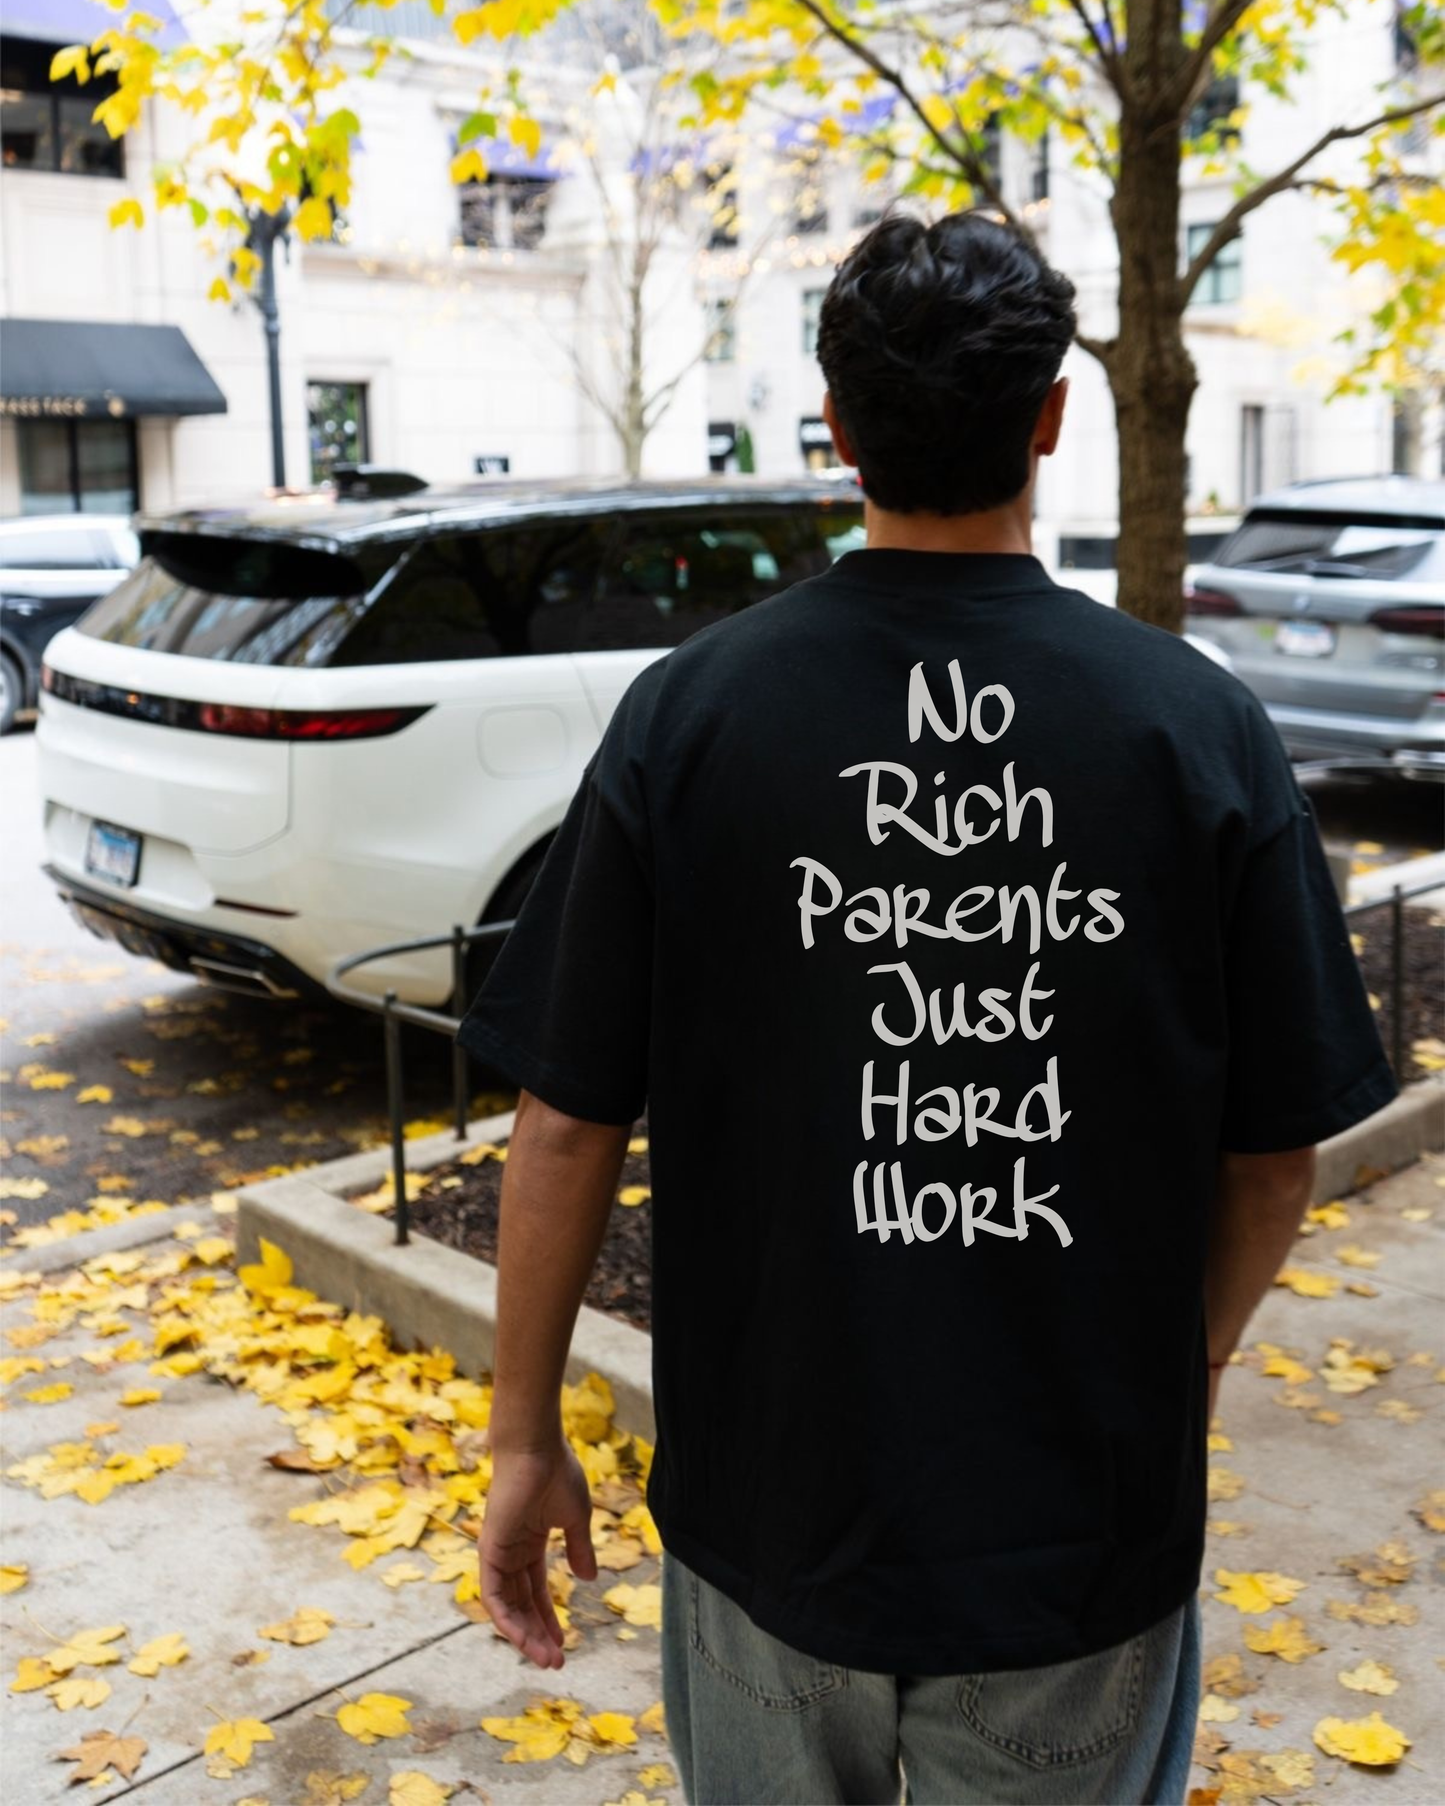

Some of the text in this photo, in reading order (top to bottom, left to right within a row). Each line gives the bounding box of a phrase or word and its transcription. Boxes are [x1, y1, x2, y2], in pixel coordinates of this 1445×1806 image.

[907, 658, 1016, 744] No
[838, 761, 1054, 857] Rich
[789, 856, 1125, 955] Parents
[866, 961, 1056, 1047] Just
[861, 1055, 1072, 1148] Hard
[853, 1156, 1074, 1248] Work
